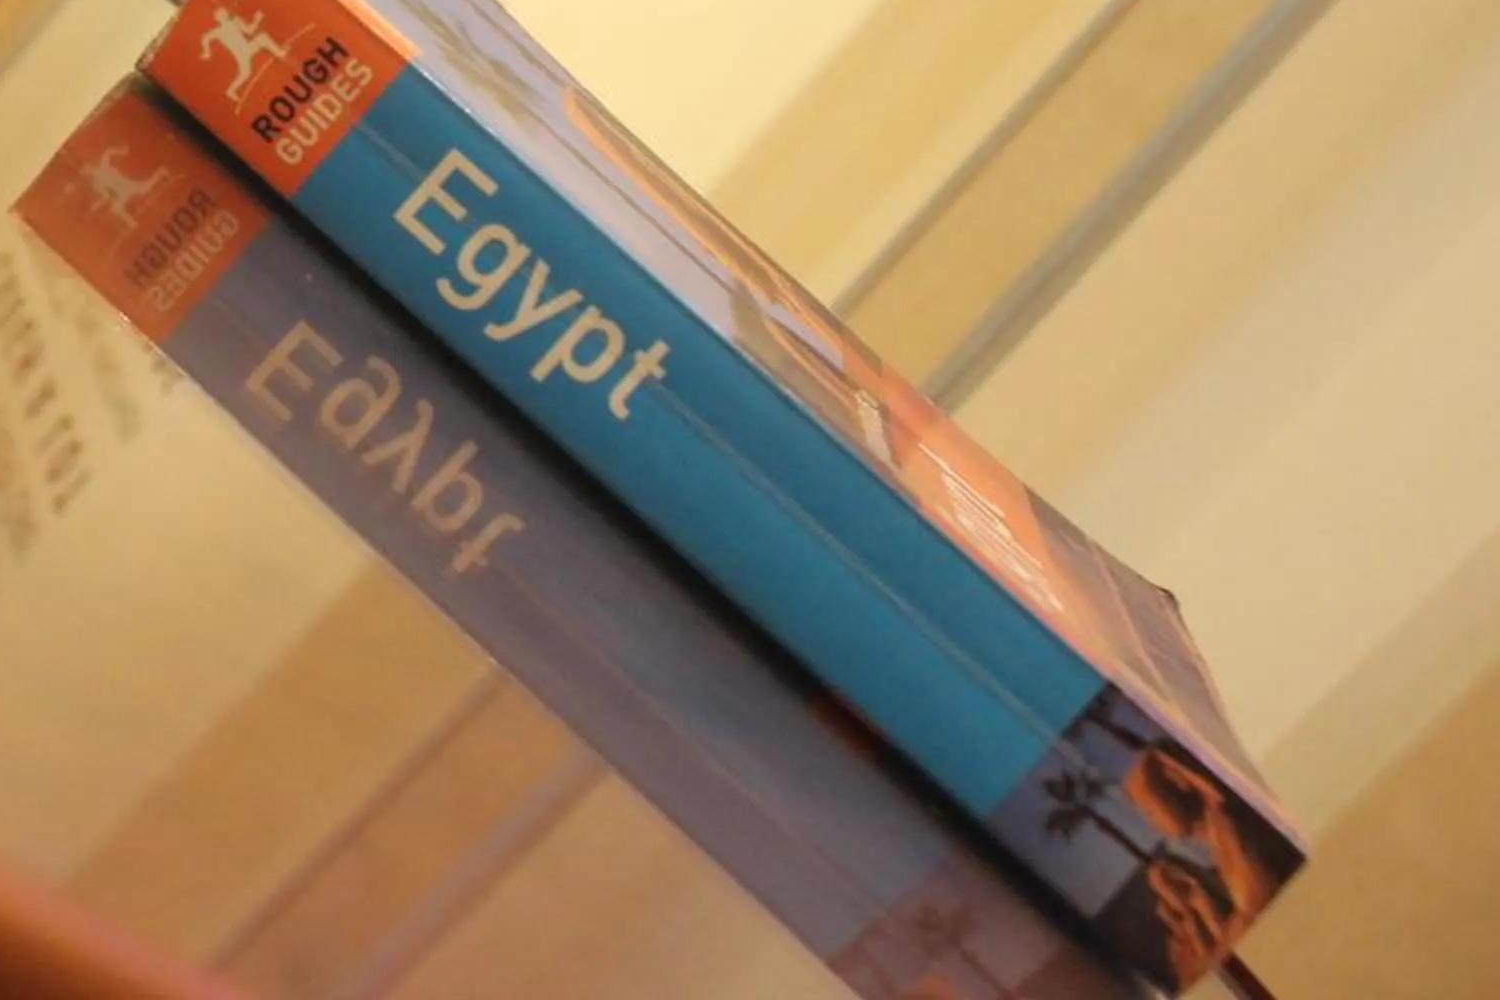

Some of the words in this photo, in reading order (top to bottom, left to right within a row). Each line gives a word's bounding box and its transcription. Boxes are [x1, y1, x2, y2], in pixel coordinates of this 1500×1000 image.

[251, 36, 351, 144] ROUGH
[275, 57, 373, 166] GUIDES
[393, 147, 671, 421] Egypt
